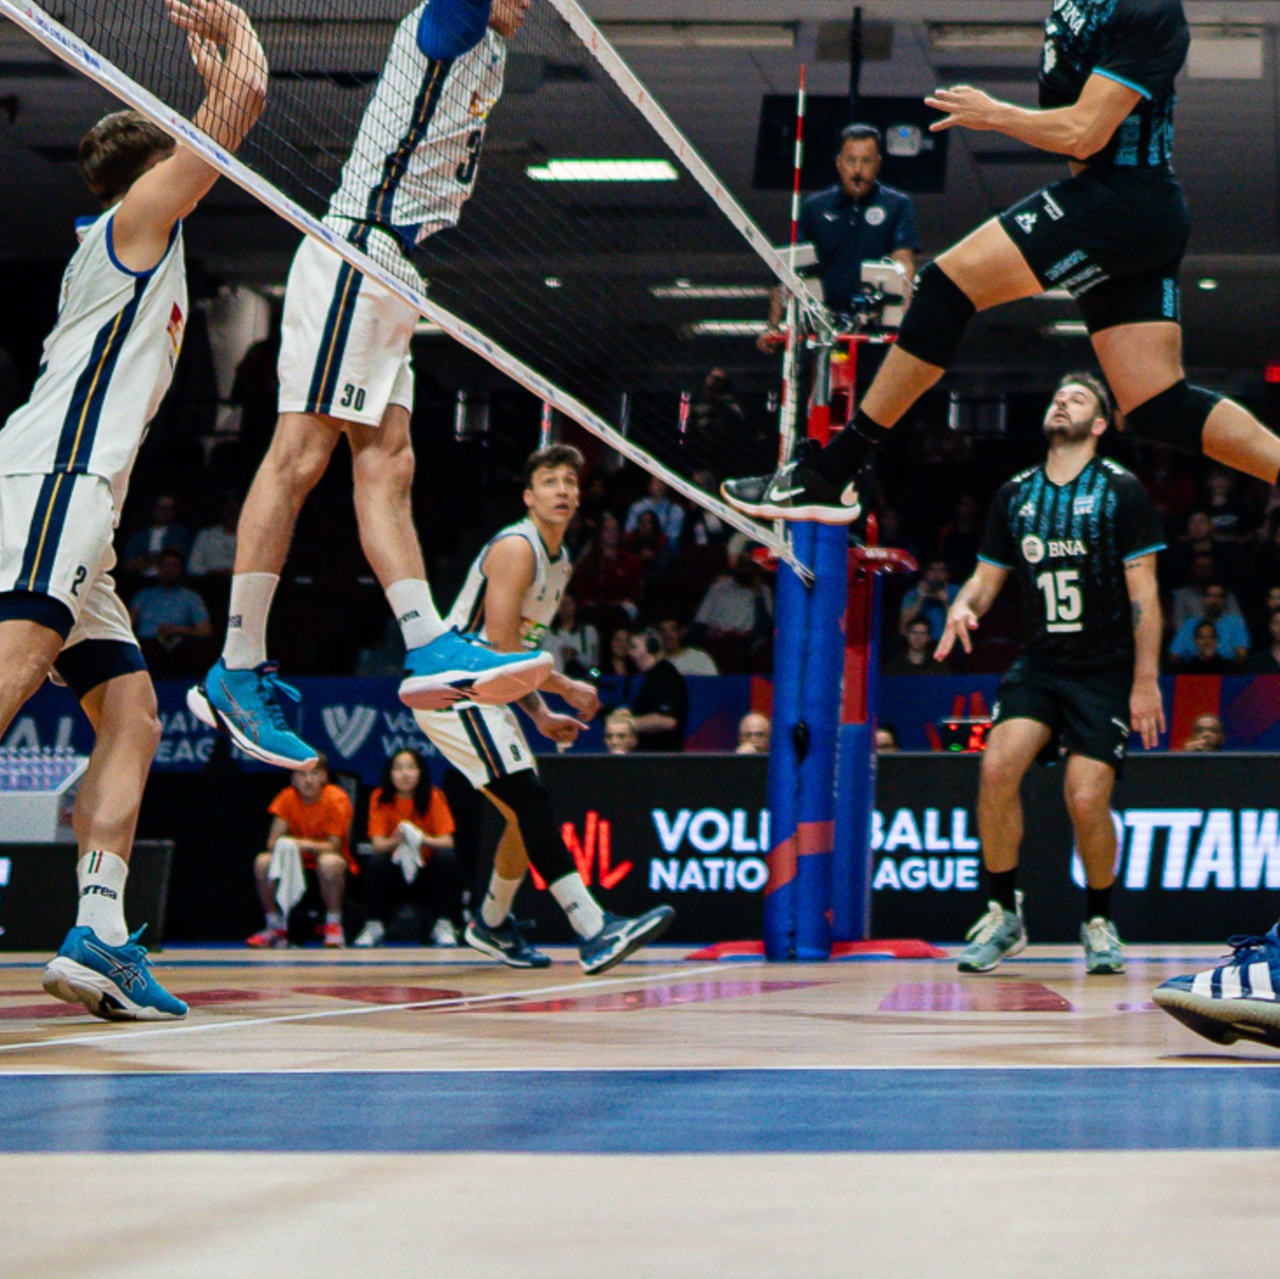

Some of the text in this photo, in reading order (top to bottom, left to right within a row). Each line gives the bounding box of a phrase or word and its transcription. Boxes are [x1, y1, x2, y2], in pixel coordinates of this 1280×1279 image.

[340, 382, 367, 412] 30
[1047, 539, 1088, 558] BNA
[1036, 570, 1083, 621] 15
[650, 806, 981, 853] VOLBALL
[527, 810, 634, 890] NL
[649, 858, 980, 891] NATIO AGUE
